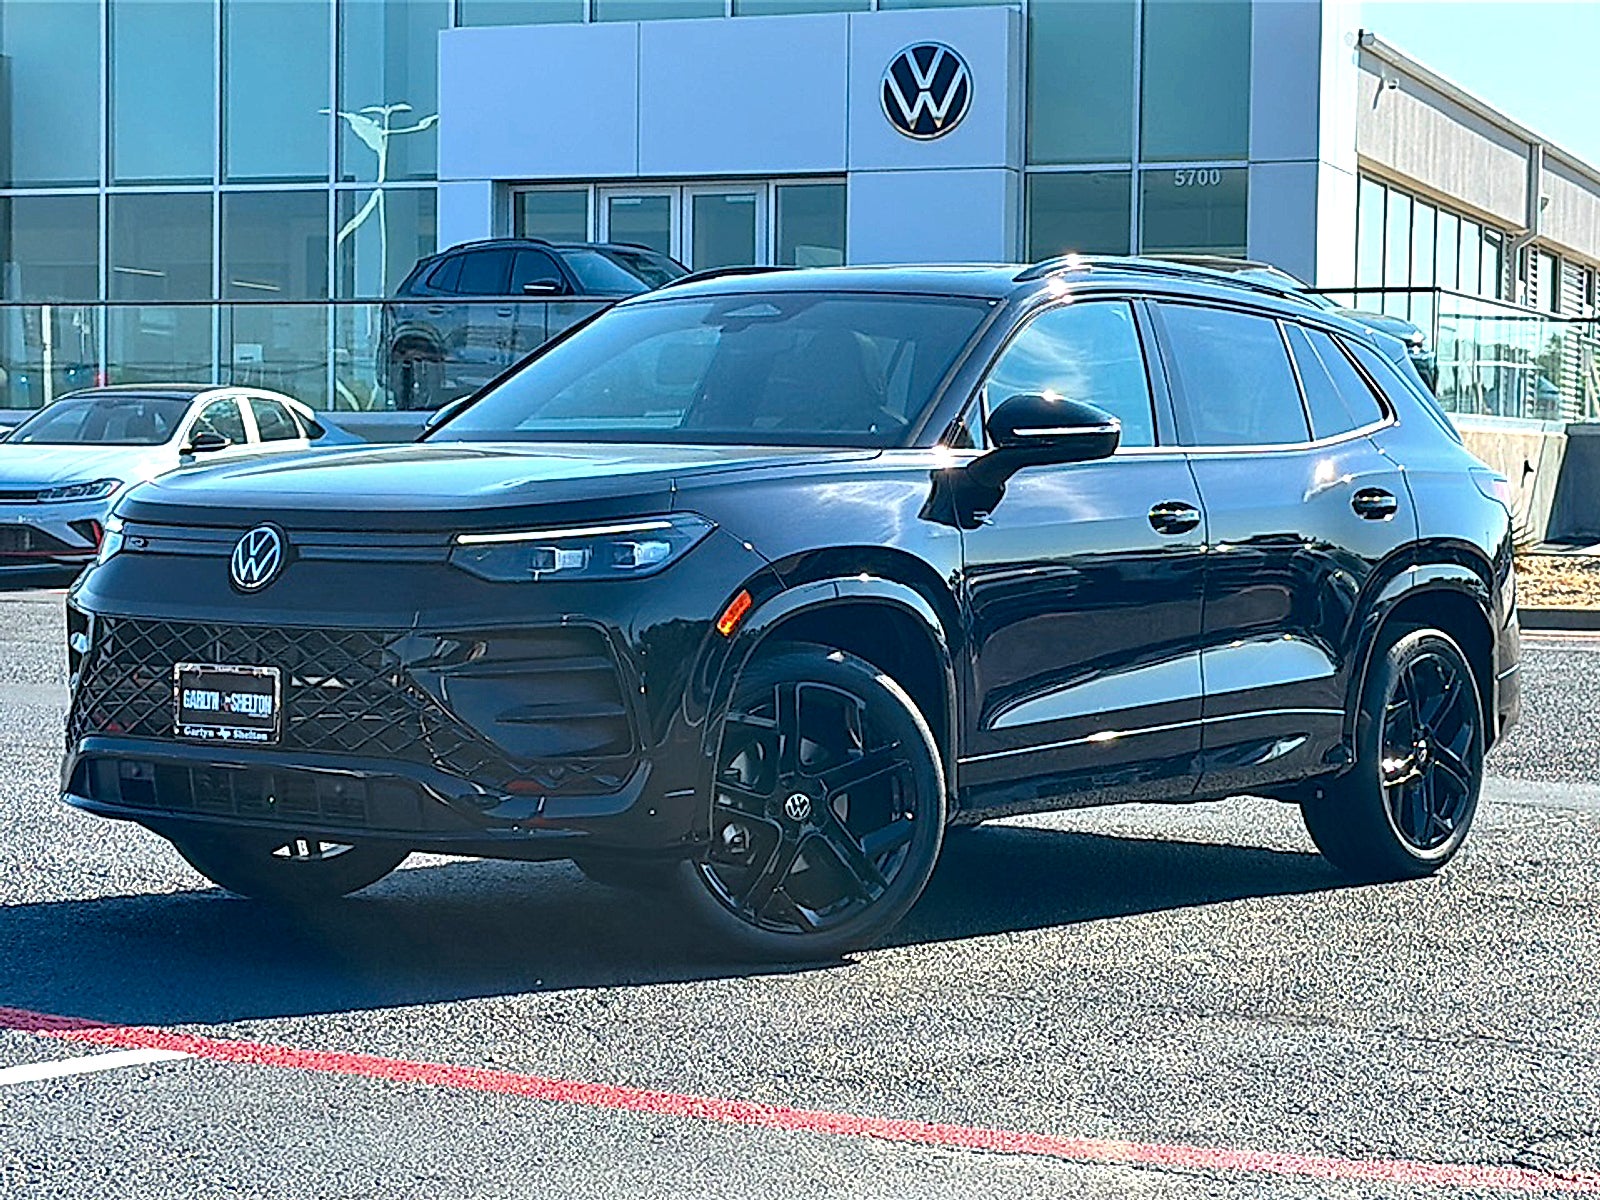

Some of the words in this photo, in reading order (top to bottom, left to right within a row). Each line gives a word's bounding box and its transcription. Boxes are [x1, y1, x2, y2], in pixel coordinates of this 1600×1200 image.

[883, 44, 970, 134] VW
[1174, 169, 1220, 186] 5700
[233, 528, 280, 586] VW
[231, 693, 273, 715] SHELTON
[785, 794, 811, 821] VW
